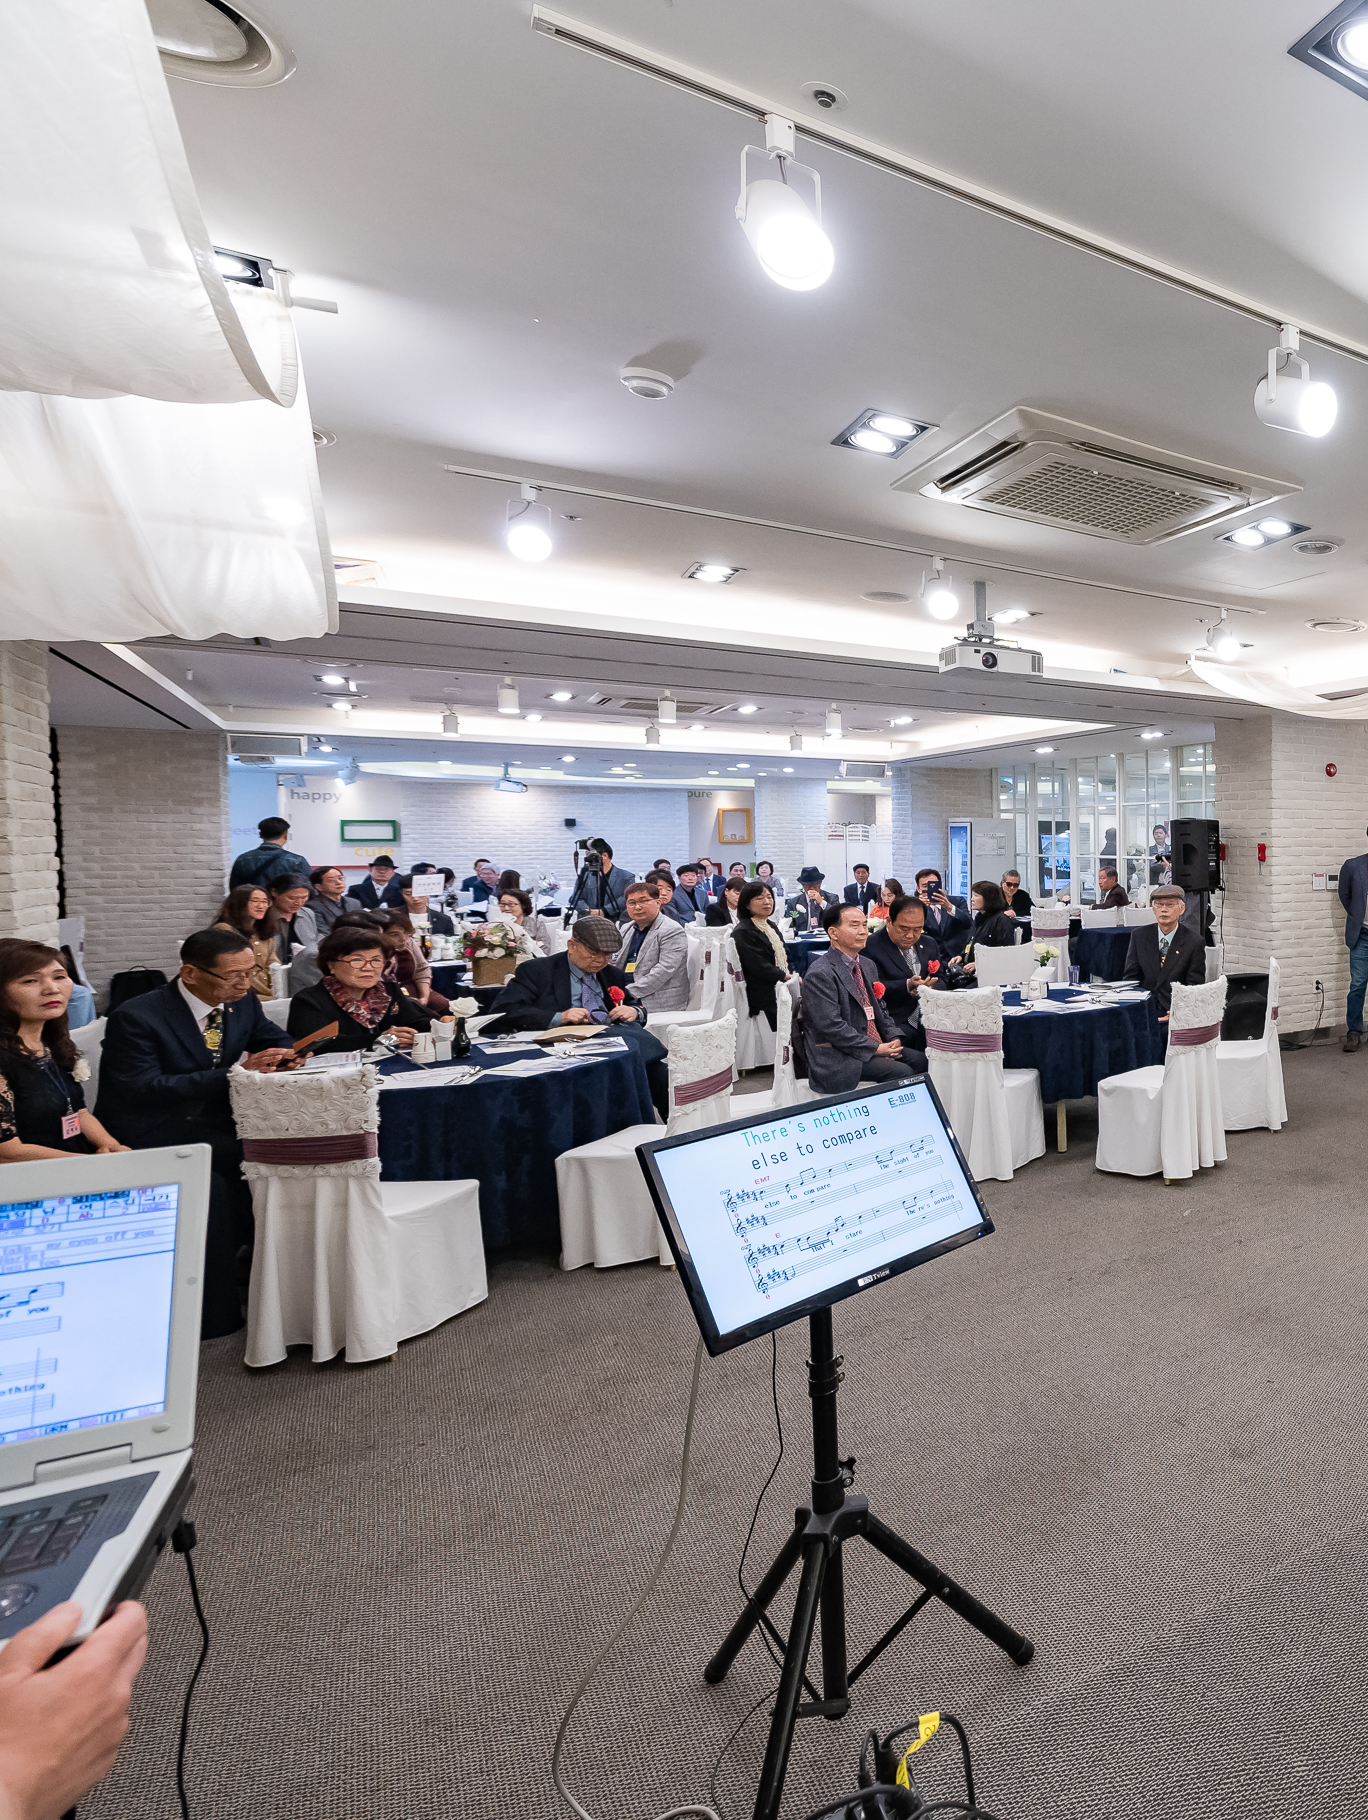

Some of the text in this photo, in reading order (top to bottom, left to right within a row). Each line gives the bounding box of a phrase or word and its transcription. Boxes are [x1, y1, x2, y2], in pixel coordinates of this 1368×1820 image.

[290, 788, 342, 803] happy
[355, 846, 395, 858] cute
[888, 1092, 916, 1106] E-808
[741, 1103, 870, 1147] There's nothing
[751, 1123, 878, 1170] else to compare
[754, 1176, 770, 1185] EM7
[764, 1200, 781, 1209] else
[0, 1383, 46, 1397] othing
